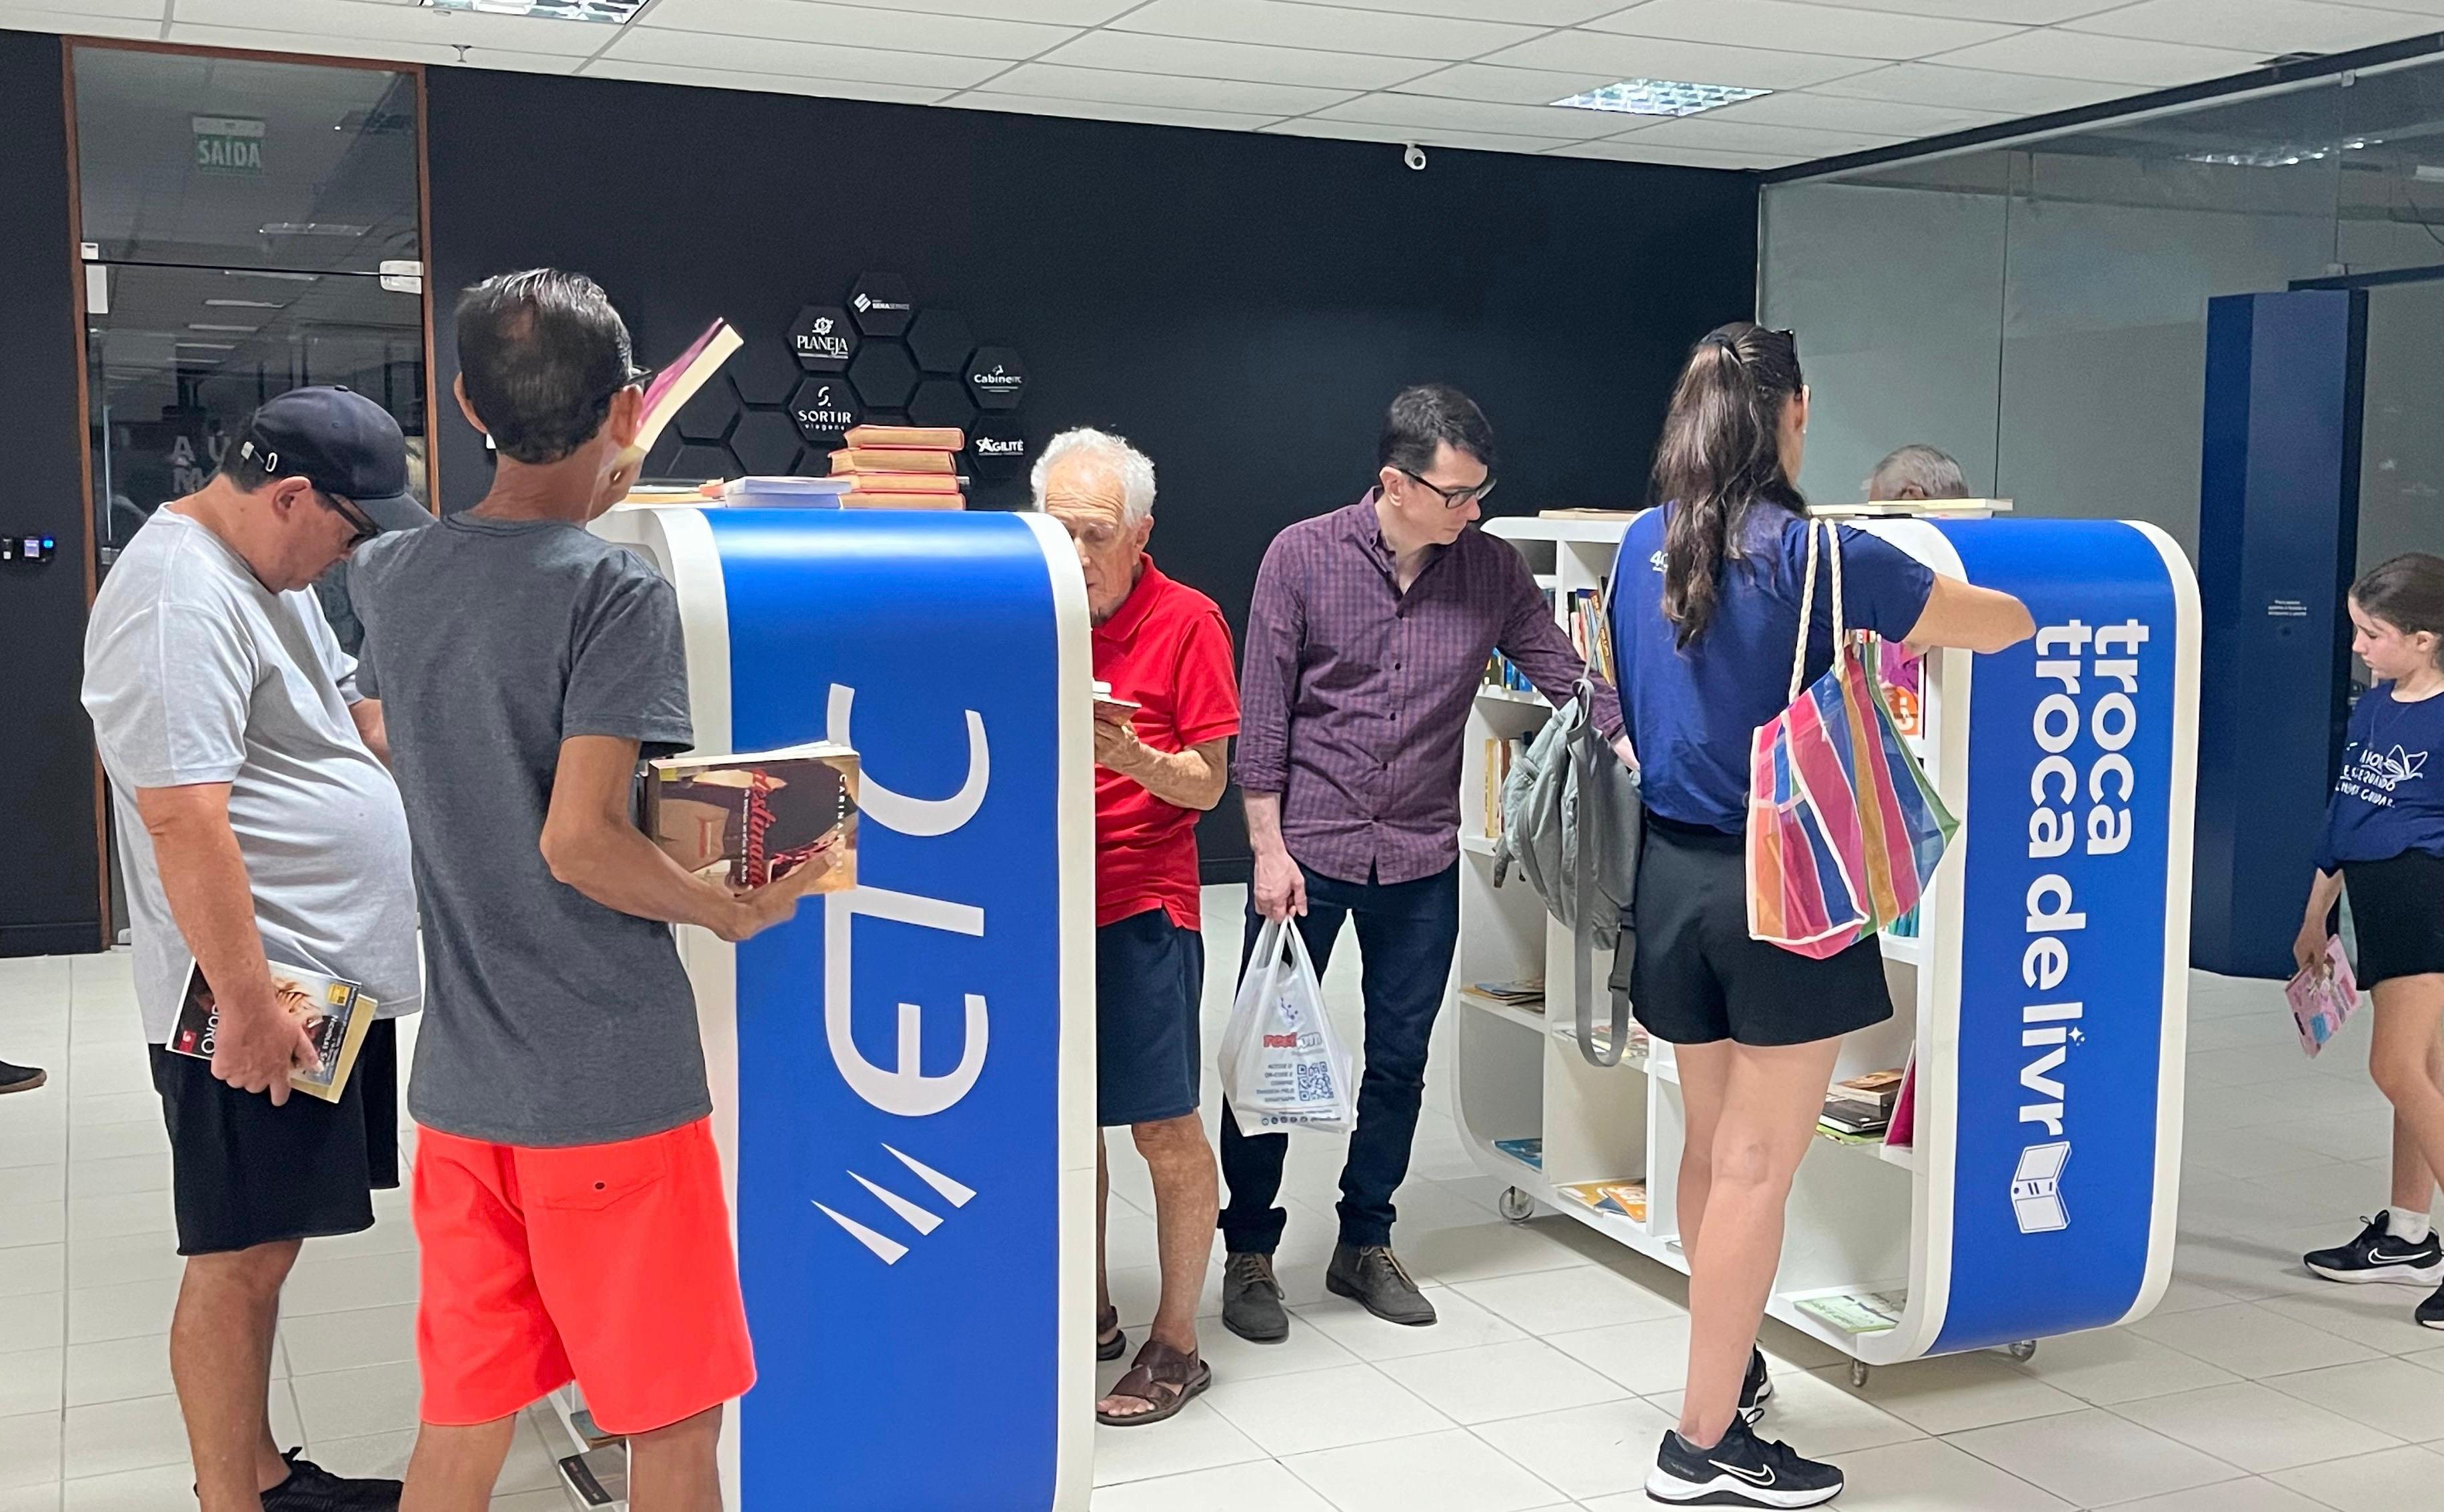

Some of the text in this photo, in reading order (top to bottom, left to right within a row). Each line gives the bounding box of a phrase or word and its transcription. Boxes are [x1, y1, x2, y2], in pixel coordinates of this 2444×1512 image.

[198, 135, 261, 168] SAÍDA
[797, 335, 848, 355] PLANEJA
[798, 410, 852, 423] SORTIR
[2029, 619, 2092, 858] troca
[2087, 619, 2149, 855] troca
[2023, 873, 2086, 991] de
